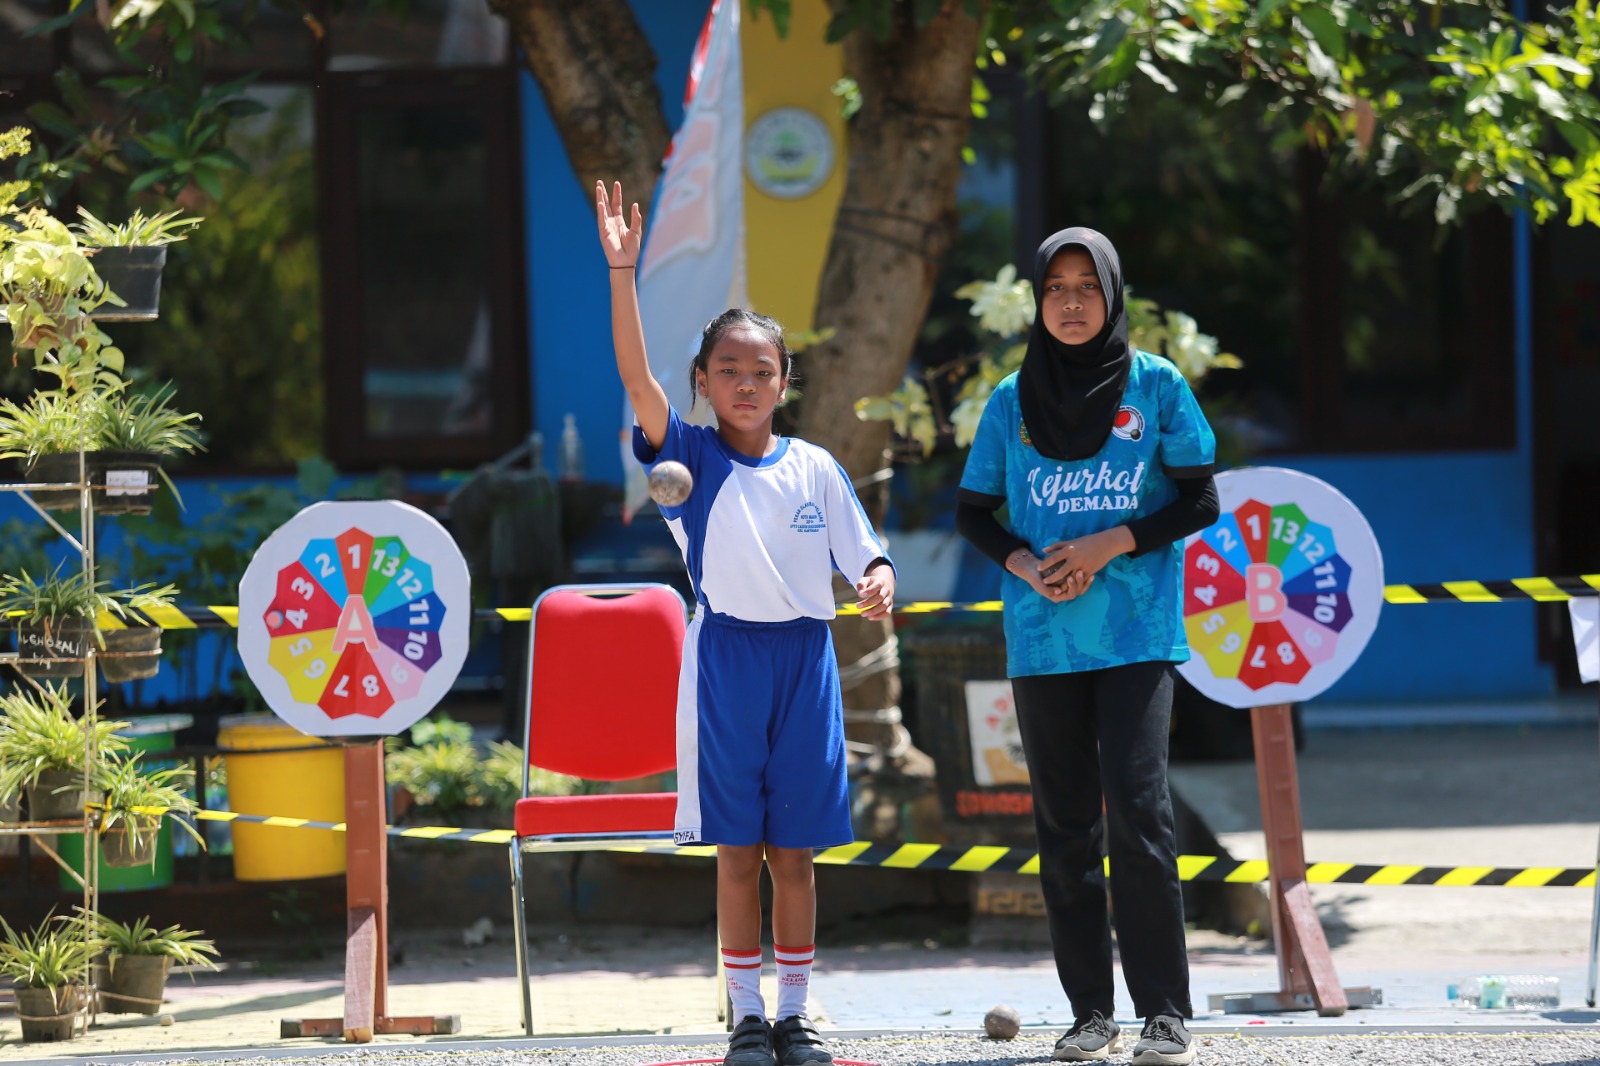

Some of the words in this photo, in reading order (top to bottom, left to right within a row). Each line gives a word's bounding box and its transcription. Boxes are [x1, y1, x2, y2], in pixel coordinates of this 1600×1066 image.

[1027, 461, 1145, 507] Kejurkot
[1057, 495, 1139, 515] DEMADA
[1247, 515, 1261, 540] 1
[1272, 517, 1300, 544] 13
[1216, 528, 1238, 552] 2
[1298, 534, 1325, 563] 12
[315, 553, 336, 578] 2
[348, 544, 360, 569] 1
[372, 549, 400, 577] 13
[1196, 554, 1220, 577] 3
[396, 568, 422, 599] 12
[1314, 562, 1337, 588] 11
[291, 577, 314, 600] 3
[1194, 585, 1217, 606] 4
[1245, 563, 1288, 623] B
[285, 609, 308, 629] 4
[409, 599, 429, 625] 11
[1314, 593, 1337, 623] 10
[331, 594, 381, 653] A
[1202, 613, 1225, 634] 5
[289, 637, 312, 657] 5
[403, 631, 428, 660] 10
[1220, 632, 1242, 654] 6
[1304, 628, 1323, 648] 9
[1251, 646, 1266, 668] 7
[1277, 642, 1295, 665] 8
[304, 658, 327, 679] 6
[391, 663, 408, 684] 9
[334, 675, 349, 697] 7
[362, 675, 380, 697] 8
[674, 831, 695, 843] SYIFA
